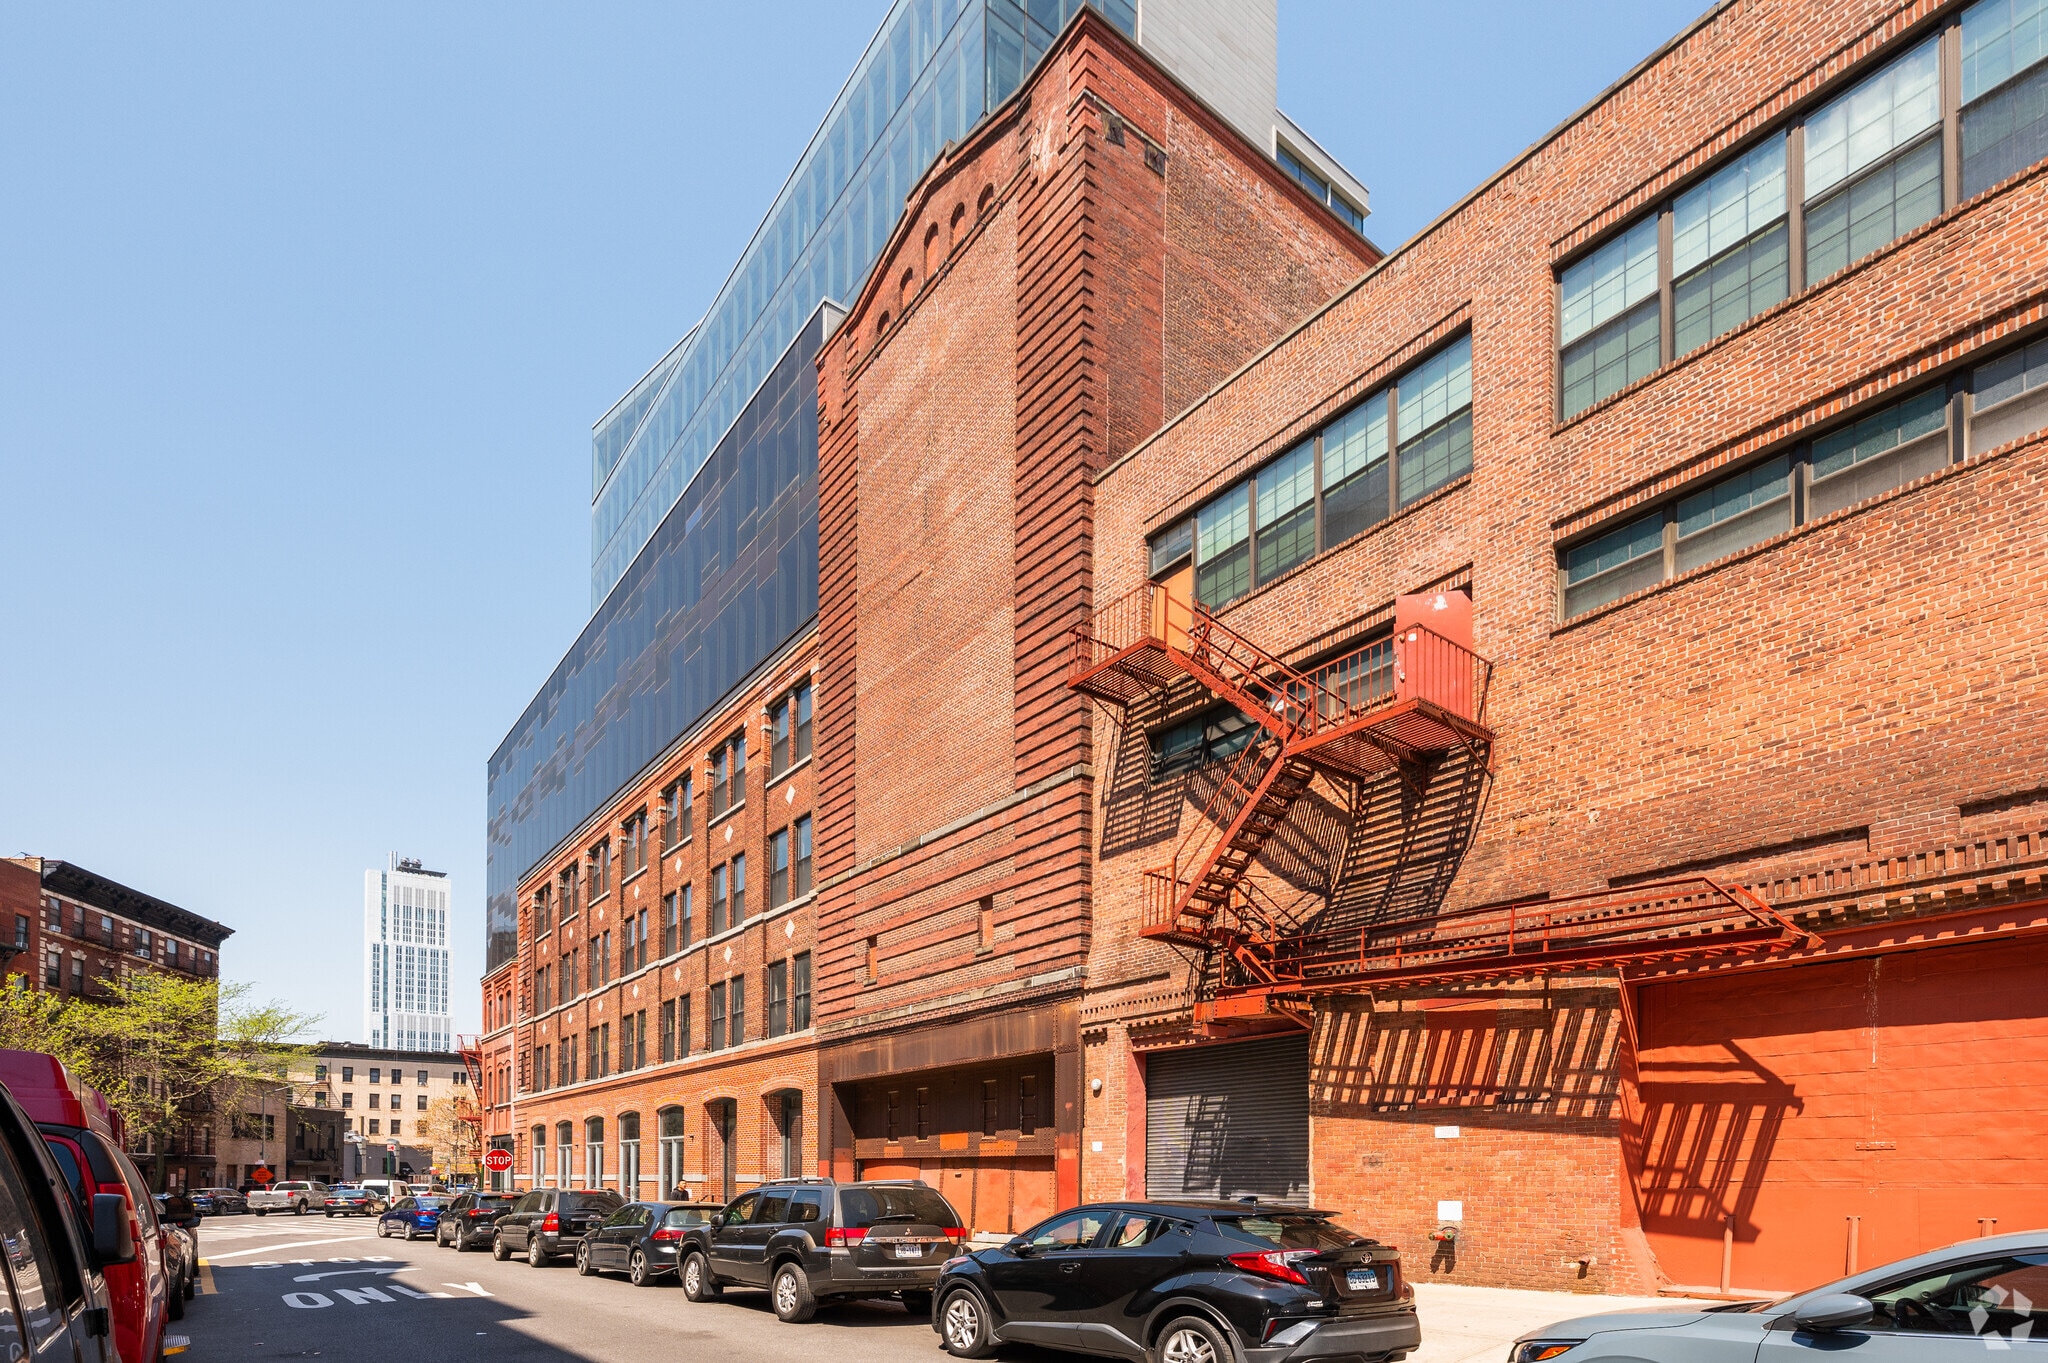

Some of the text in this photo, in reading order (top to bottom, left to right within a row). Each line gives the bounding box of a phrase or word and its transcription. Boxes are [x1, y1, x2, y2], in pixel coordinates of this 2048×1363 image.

[486, 1156, 511, 1165] STOP
[249, 1255, 394, 1269] STOP
[281, 1282, 495, 1309] ONLY
